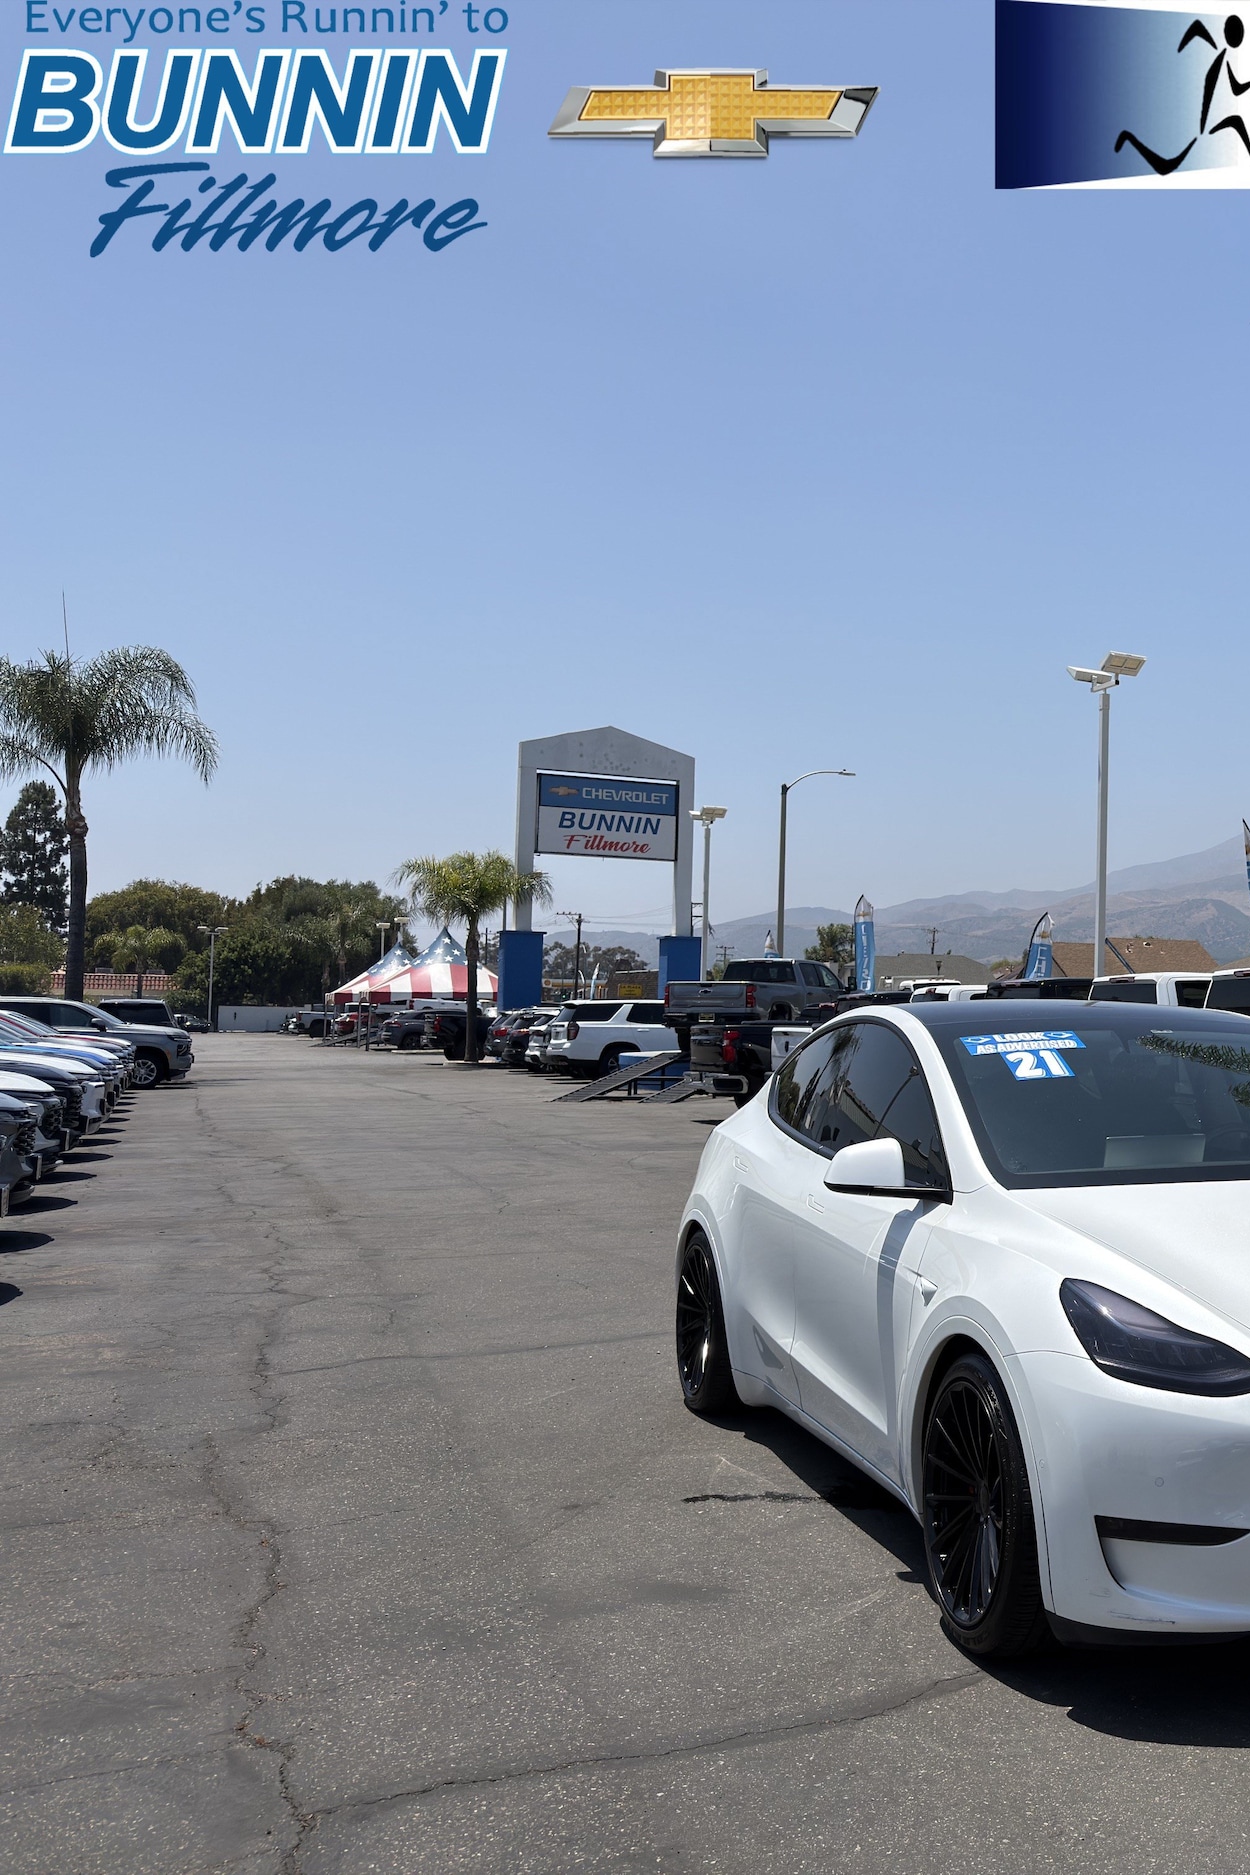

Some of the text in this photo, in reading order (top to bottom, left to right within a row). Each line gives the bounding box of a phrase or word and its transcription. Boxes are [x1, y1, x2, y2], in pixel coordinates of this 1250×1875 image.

[582, 787, 669, 805] CHEVROLET
[558, 811, 661, 835] BUNNIN
[563, 834, 652, 854] Fillmore
[992, 1032, 1048, 1042] LOOK
[976, 1039, 1077, 1055] AS ADVERTISED
[1005, 1050, 1069, 1078] 21
